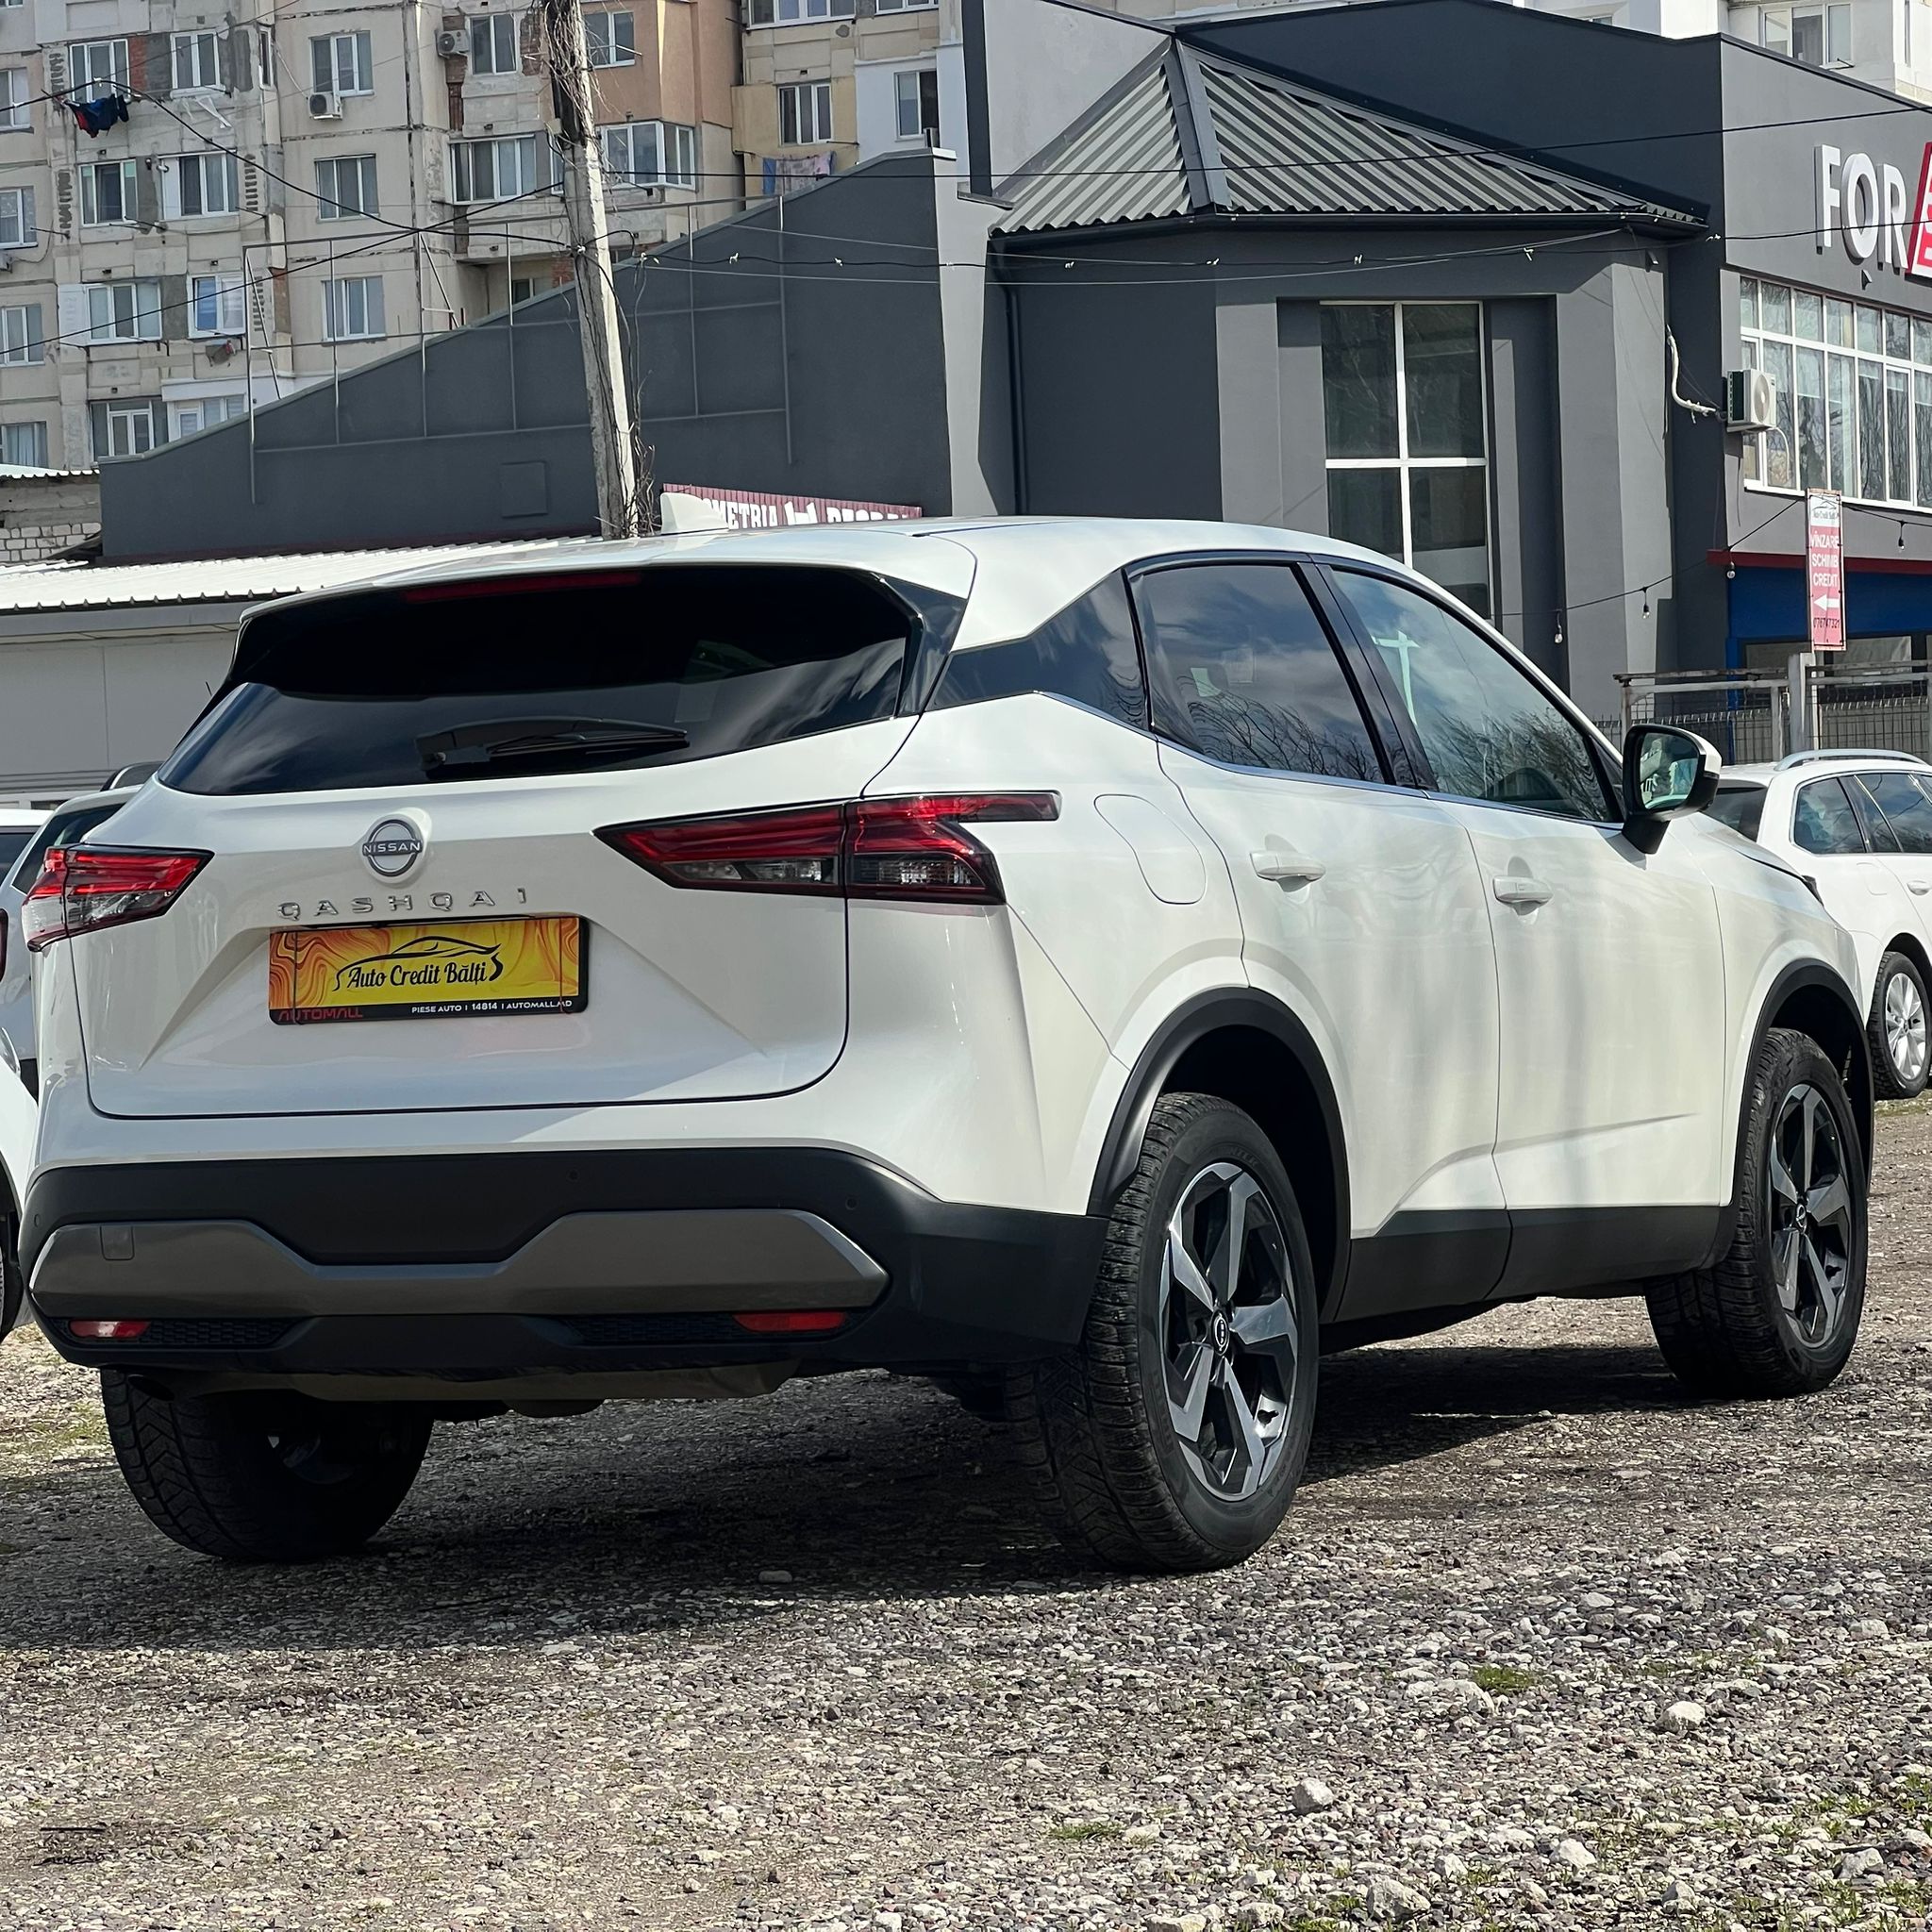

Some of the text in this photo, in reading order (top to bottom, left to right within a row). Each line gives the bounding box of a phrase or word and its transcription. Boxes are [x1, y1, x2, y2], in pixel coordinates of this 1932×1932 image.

[1811, 553, 1840, 568] SCHIMB
[1813, 573, 1840, 588] CREDIT
[363, 841, 422, 854] NISSAN
[276, 888, 527, 921] QASHQAI
[347, 967, 388, 989] Auto
[390, 964, 441, 987] Credit
[472, 1002, 498, 1011] 14814
